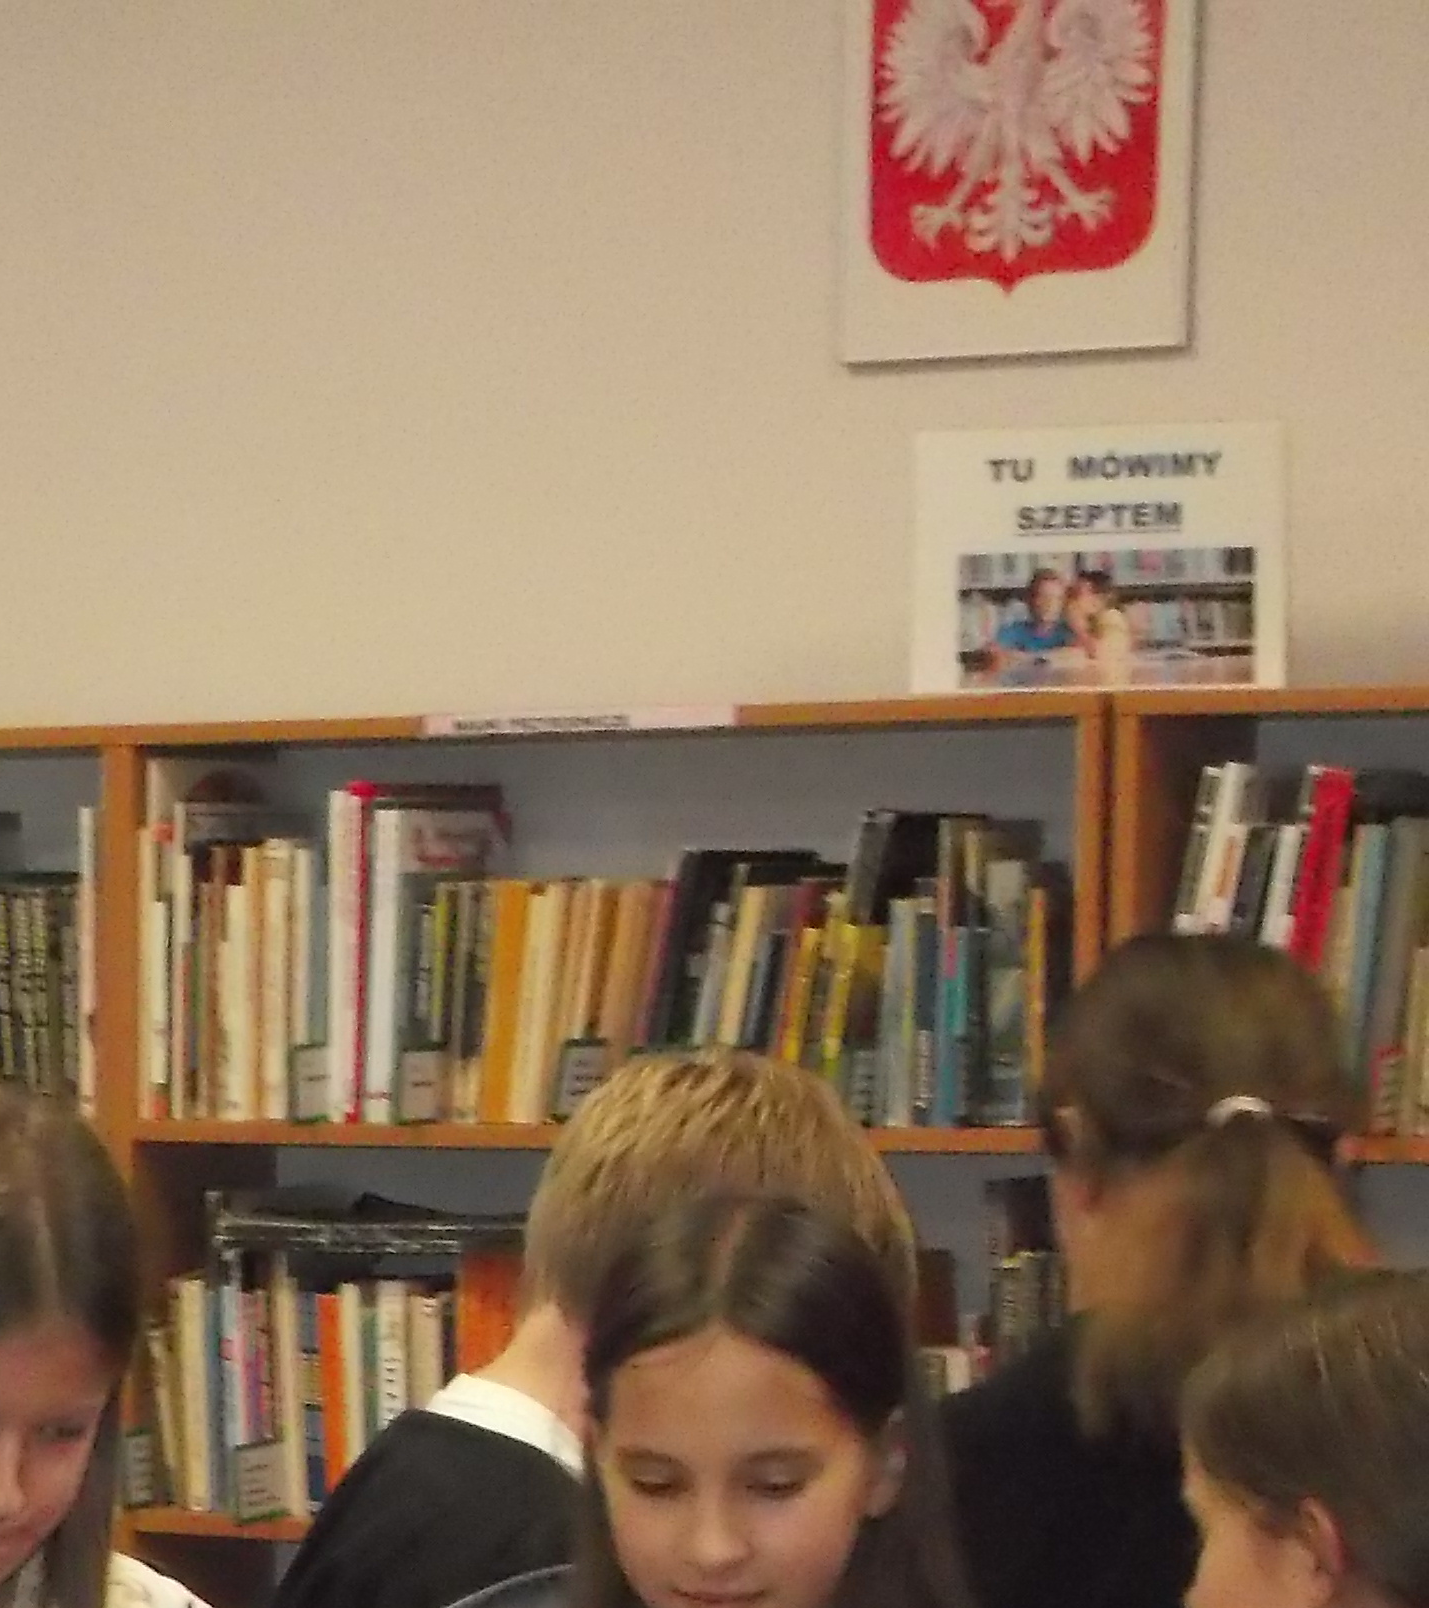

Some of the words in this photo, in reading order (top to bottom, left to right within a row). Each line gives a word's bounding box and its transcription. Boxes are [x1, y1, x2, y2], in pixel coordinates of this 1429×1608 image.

[985, 457, 1035, 483] TU
[1066, 450, 1223, 481] MÓWIMY
[1016, 500, 1183, 530] SZEPTEM
